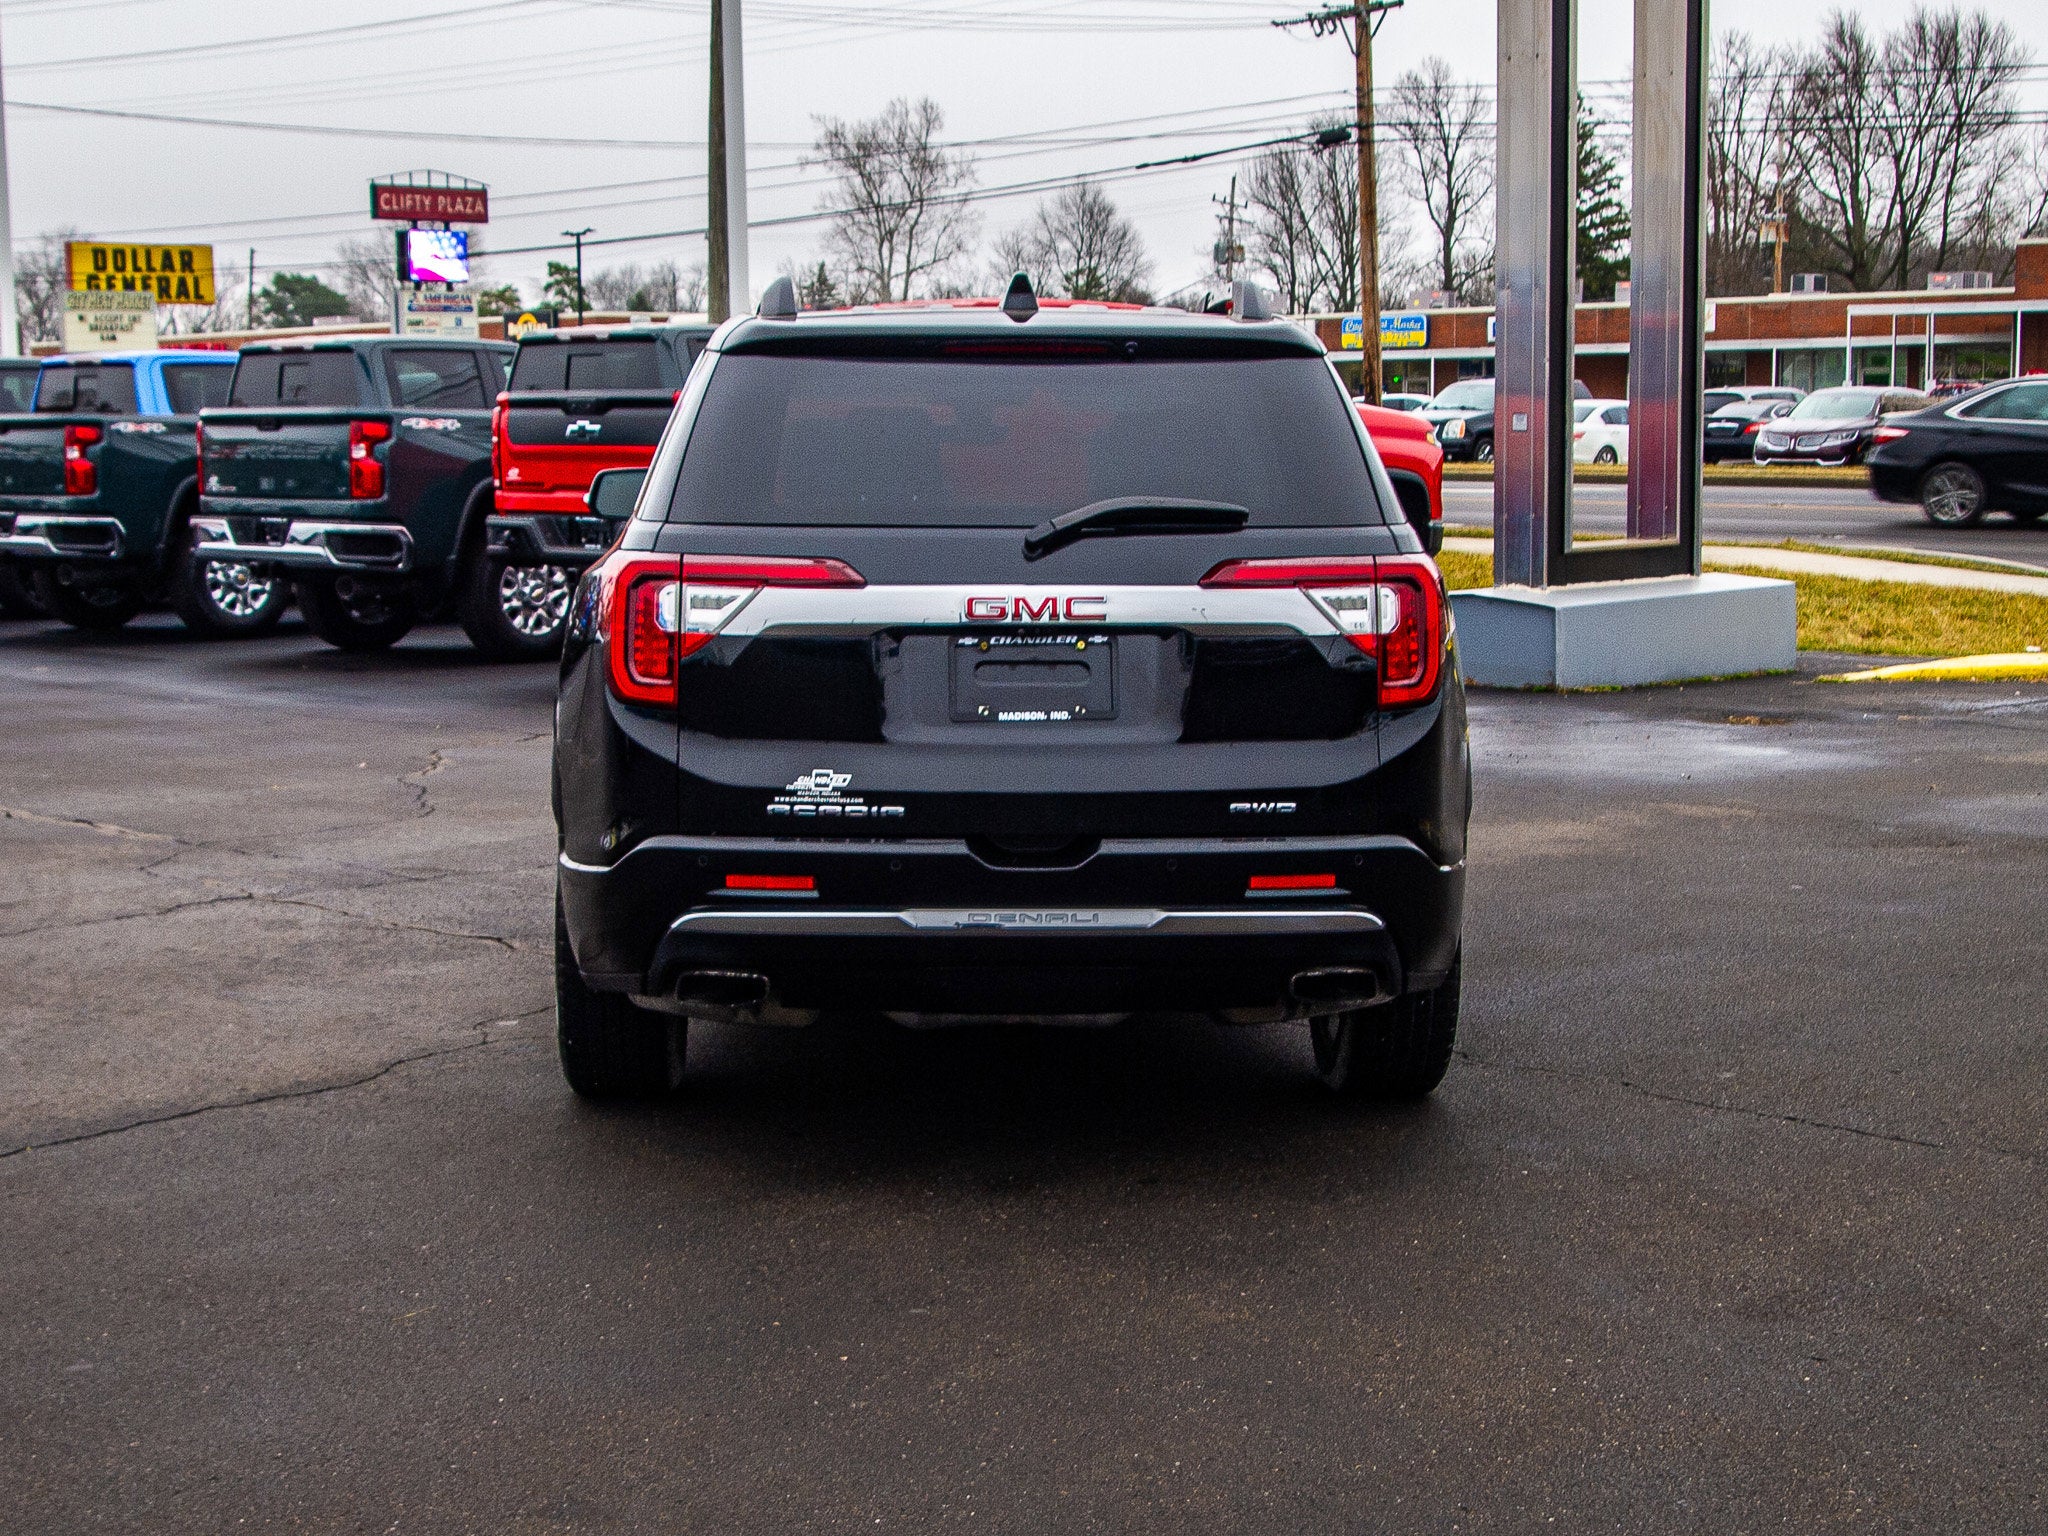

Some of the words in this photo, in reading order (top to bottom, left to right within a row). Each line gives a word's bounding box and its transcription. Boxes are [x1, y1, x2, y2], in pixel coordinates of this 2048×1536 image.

[380, 192, 432, 211] CLIFTY
[437, 195, 485, 213] PLAZA
[91, 247, 195, 273] DOLLAR
[86, 273, 205, 300] GENERAL
[966, 596, 1107, 621] GMC
[990, 635, 1077, 645] CHANDLER
[766, 804, 905, 817] ACADIA
[1230, 802, 1297, 814] AWD
[968, 912, 1099, 924] DENALI
